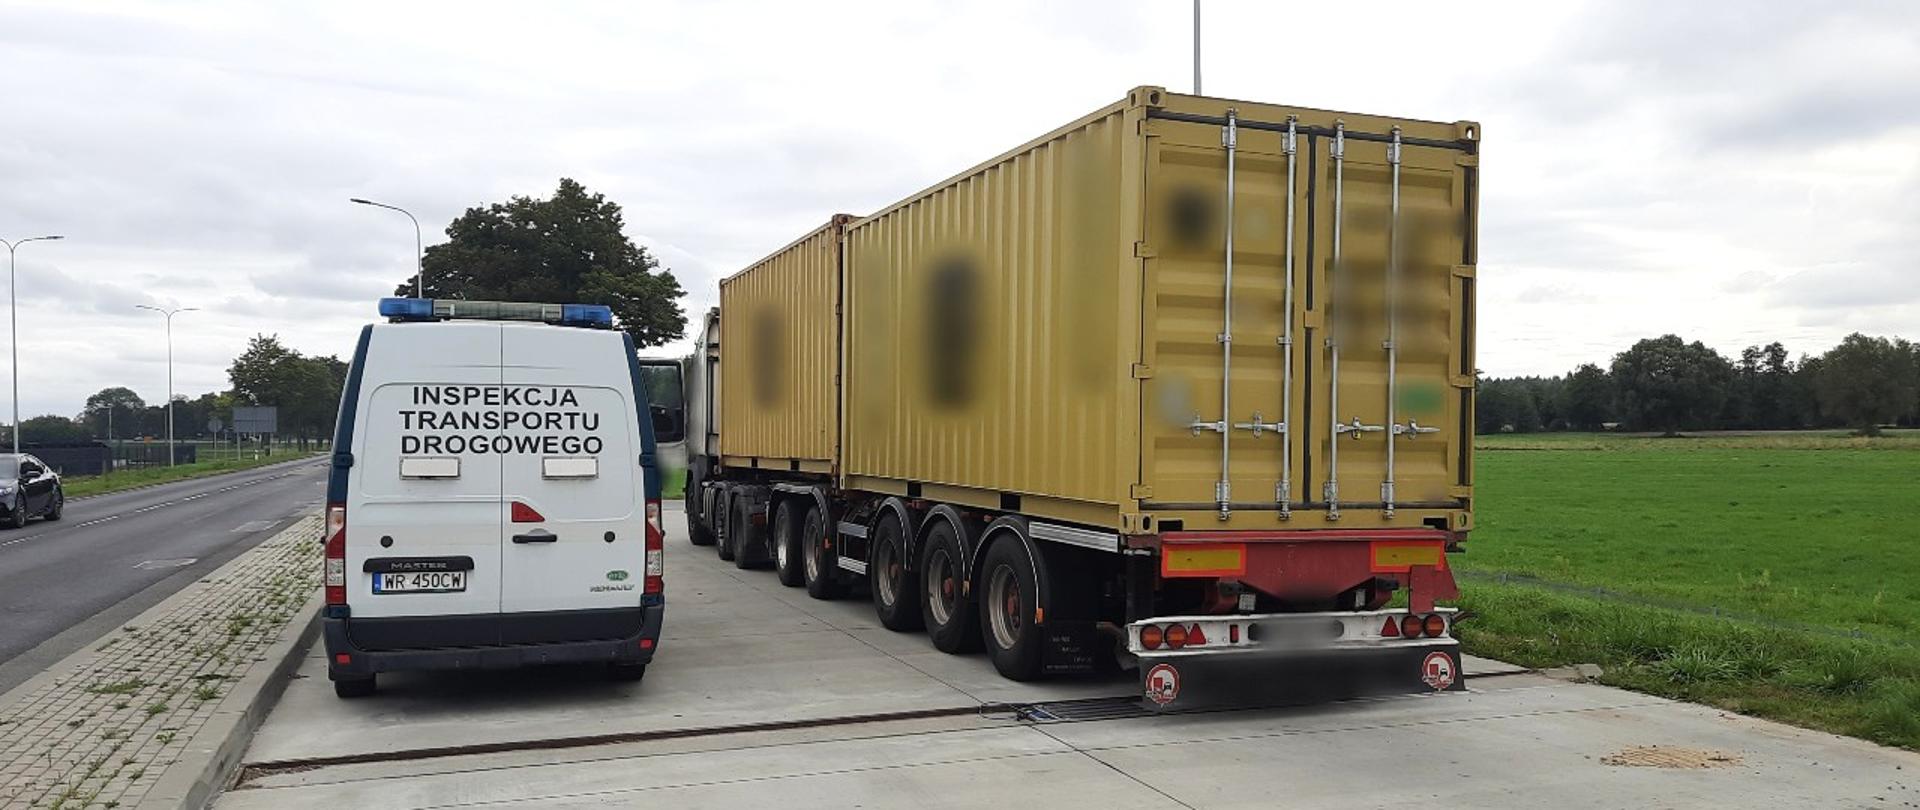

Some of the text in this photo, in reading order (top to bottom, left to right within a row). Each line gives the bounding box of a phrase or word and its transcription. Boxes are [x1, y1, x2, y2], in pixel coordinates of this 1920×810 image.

[413, 386, 579, 407] INSPEKCJA
[399, 410, 600, 431] TRANSPORTU
[401, 435, 603, 454] DROGOWEGO
[385, 573, 461, 589] WR 450CW
